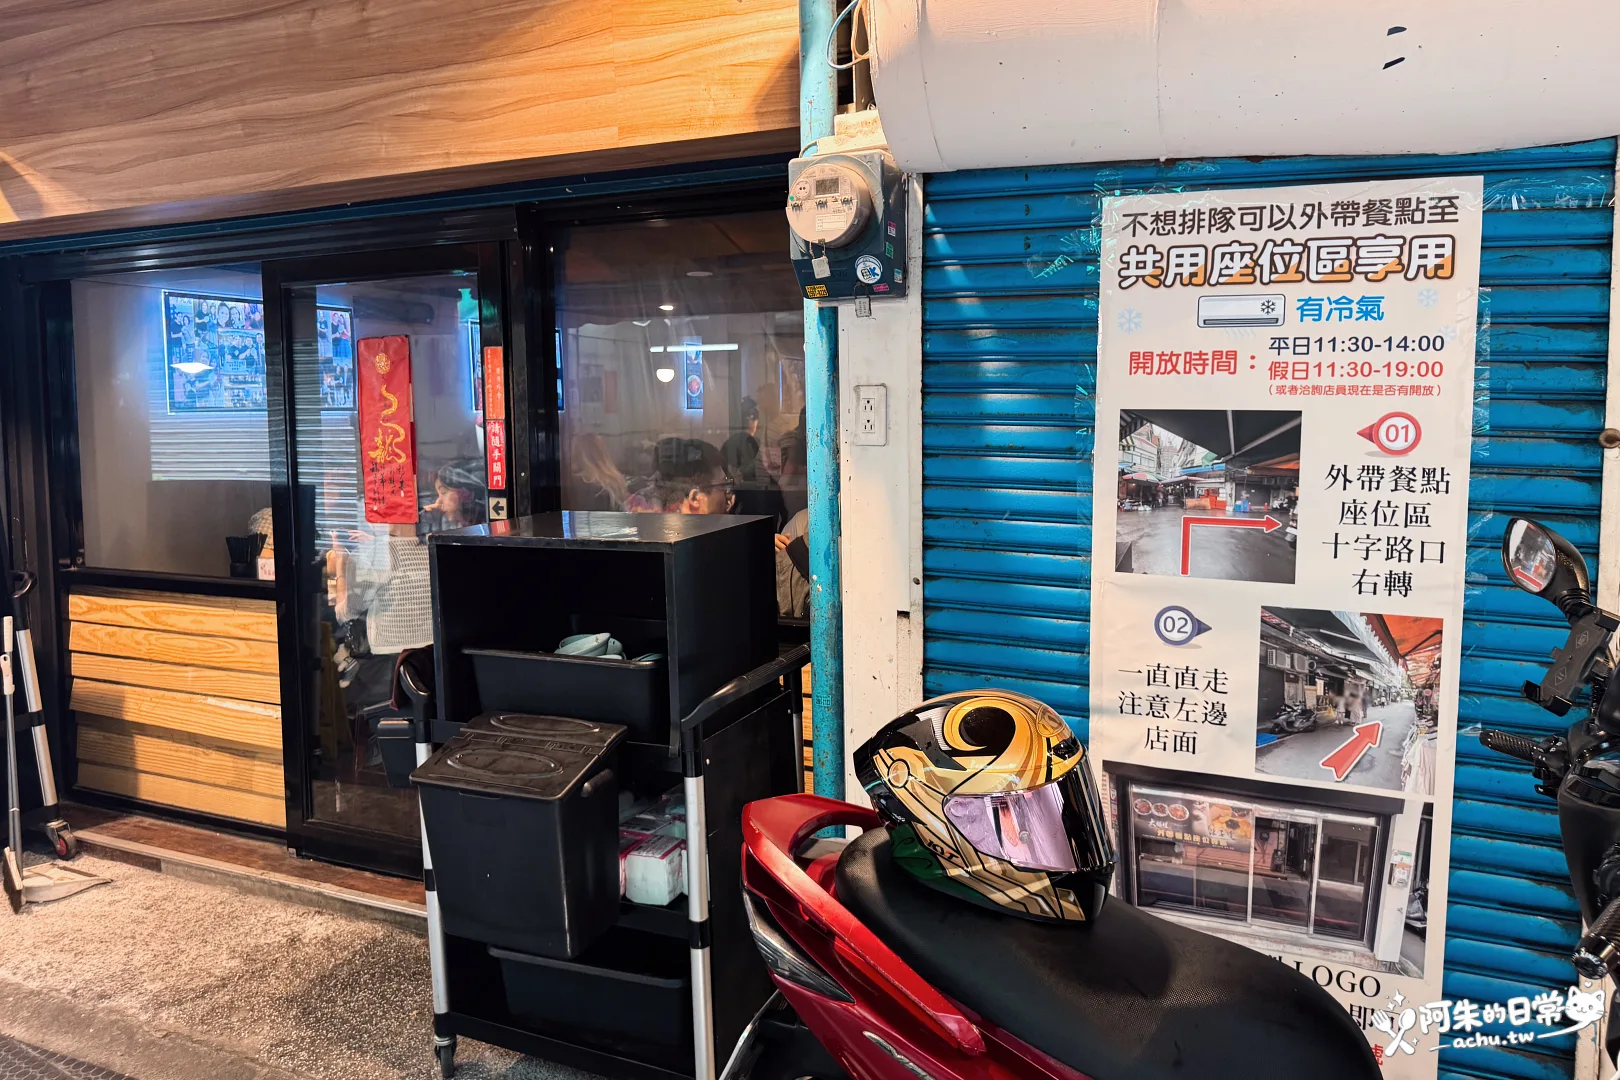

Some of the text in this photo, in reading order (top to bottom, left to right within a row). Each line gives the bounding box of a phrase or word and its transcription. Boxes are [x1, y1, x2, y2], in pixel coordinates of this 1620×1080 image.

[1120, 195, 1460, 238] 不想排隊可以外帶餐點至
[1117, 233, 1456, 291] 共用座位區享用
[1295, 295, 1386, 323] 有冷氣
[1268, 335, 1445, 356] 平日11:30-14:00
[1268, 360, 1444, 381] 假日11:30-19:00
[1385, 424, 1410, 443] 01
[1324, 464, 1451, 495] 外帶餐點
[1338, 499, 1432, 529] 座位區
[1322, 532, 1446, 564] 十字路口
[1352, 568, 1413, 598] 右轉
[1163, 615, 1189, 634] 02
[1118, 663, 1229, 695] 一直直走
[1118, 690, 1228, 727] 注意左邊
[1144, 725, 1198, 755] 店面
